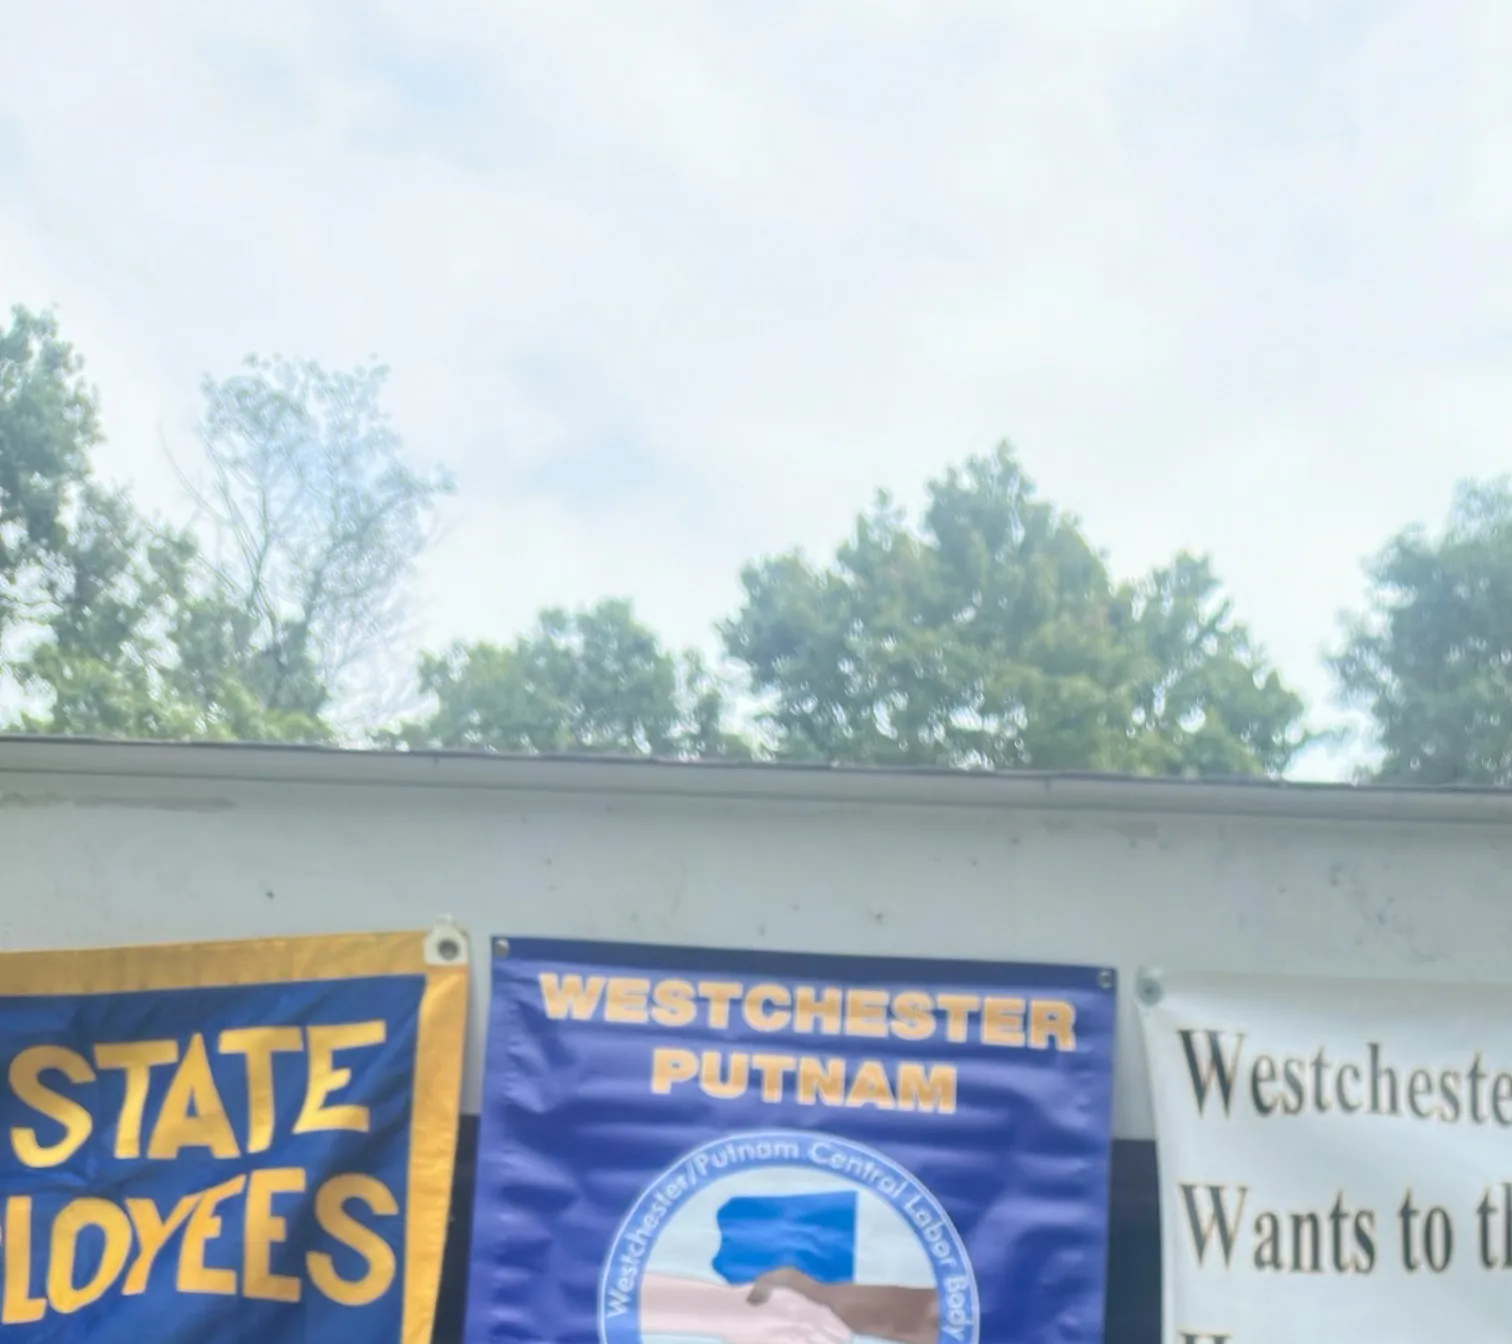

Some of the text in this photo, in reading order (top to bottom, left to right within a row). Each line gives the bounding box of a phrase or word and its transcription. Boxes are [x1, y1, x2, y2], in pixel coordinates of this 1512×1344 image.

[538, 972, 1077, 1052] WESTCHESTER
[6, 1020, 388, 1169] STATE
[651, 1048, 957, 1116] PUTNAM
[0, 1167, 400, 1326] LOYEES
[808, 1140, 903, 1199] Central
[902, 1184, 956, 1272] Labor
[943, 1273, 975, 1344] Body
[1179, 1183, 1377, 1274] Wants
[1398, 1188, 1454, 1274] to
